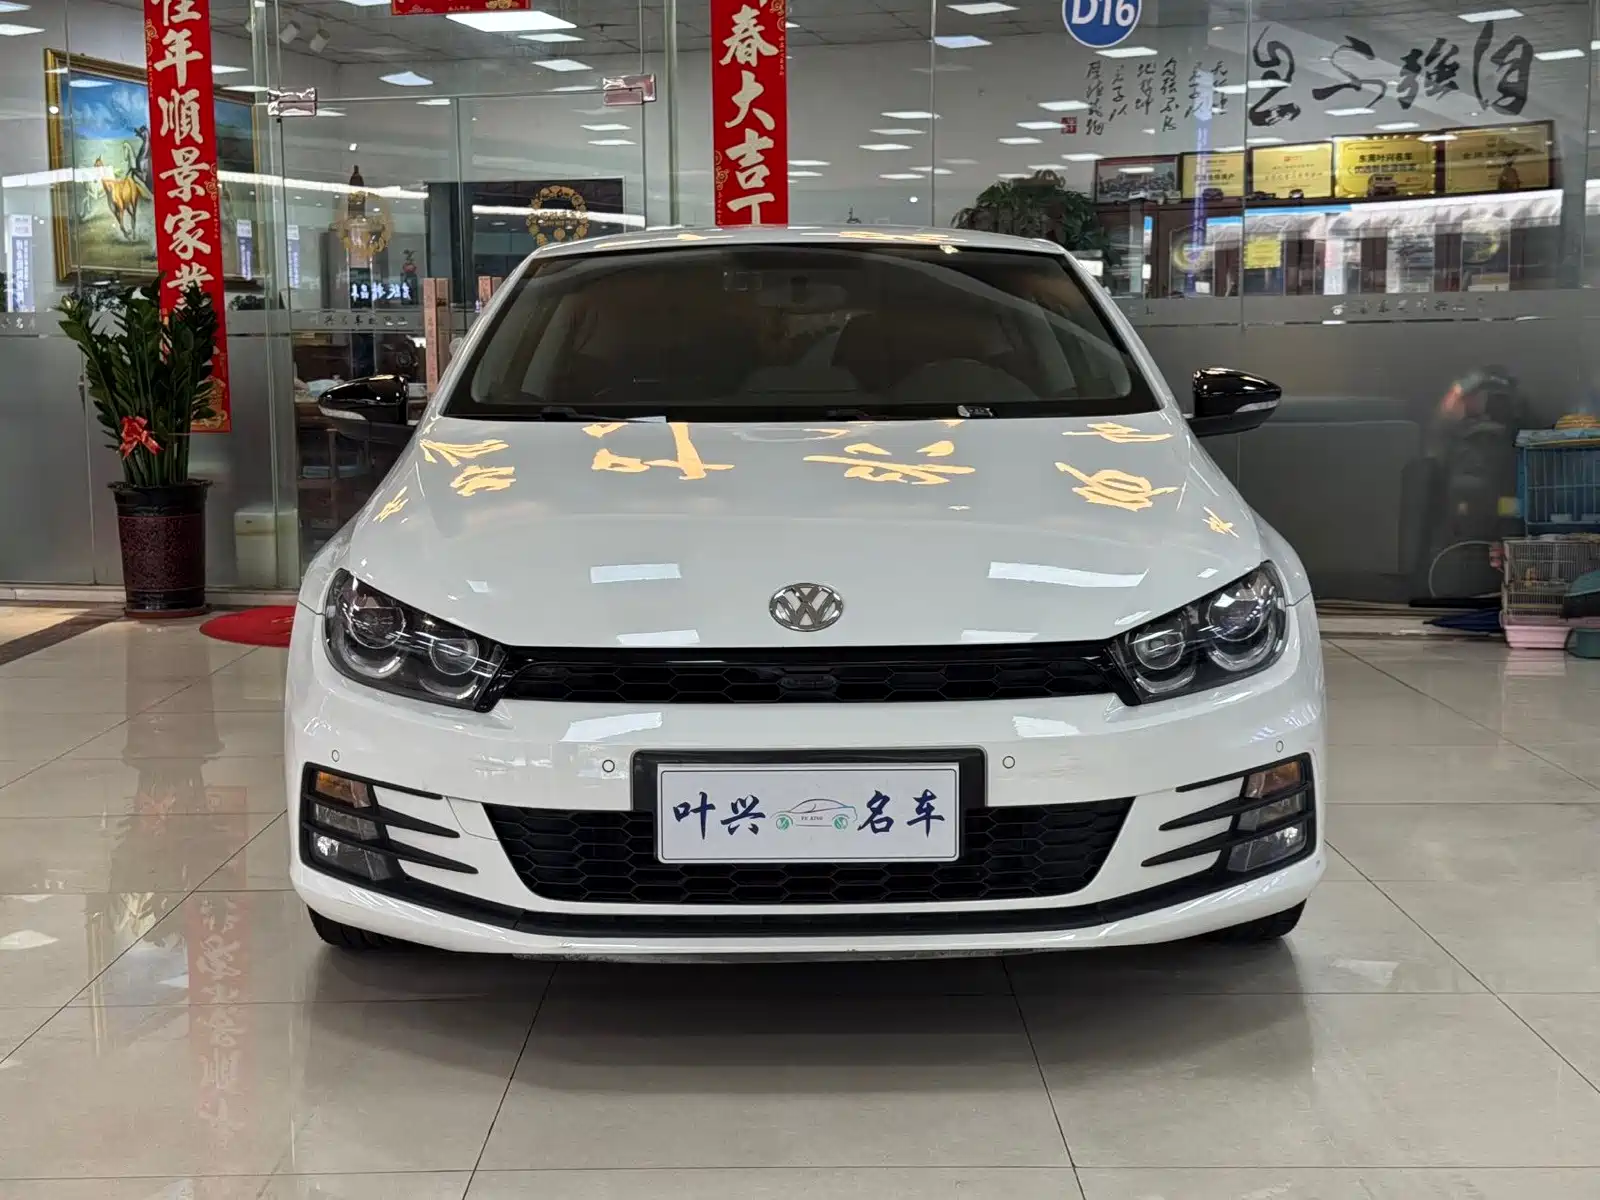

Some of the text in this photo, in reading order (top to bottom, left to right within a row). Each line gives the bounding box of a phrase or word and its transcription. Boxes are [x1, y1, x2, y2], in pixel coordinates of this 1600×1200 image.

[1071, 0, 1135, 27] D16
[673, 788, 945, 840] 叶兴 名车
